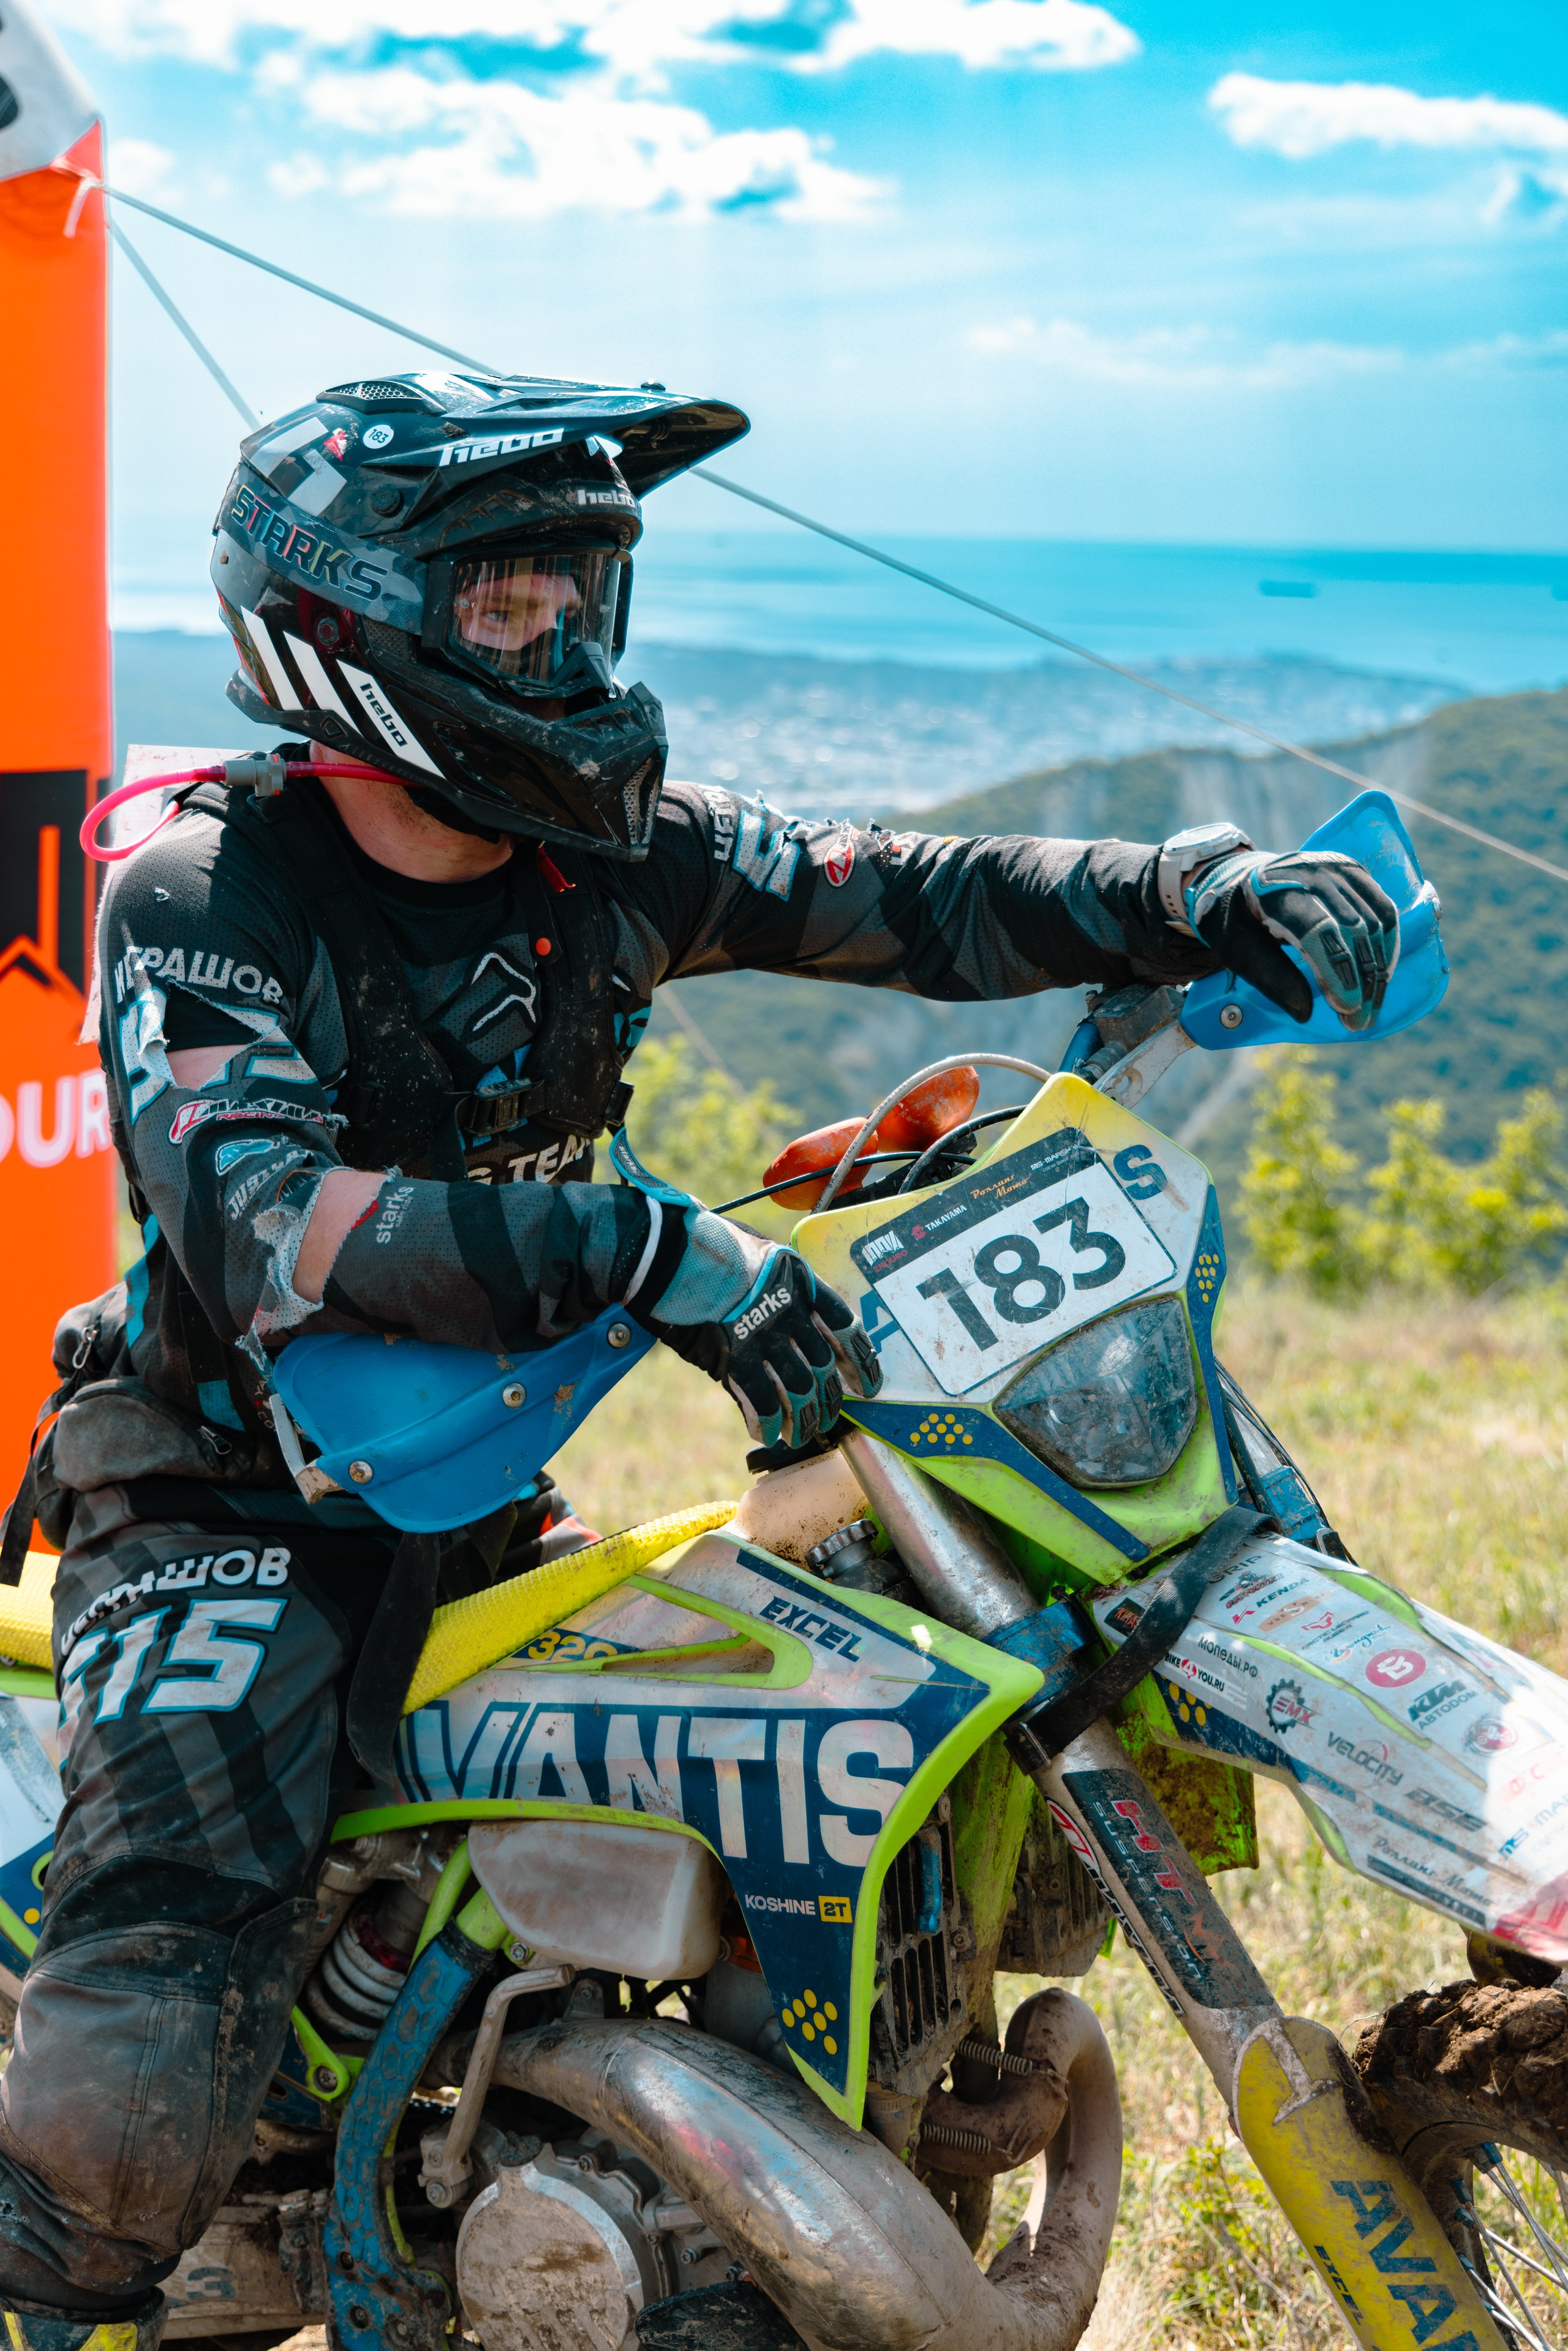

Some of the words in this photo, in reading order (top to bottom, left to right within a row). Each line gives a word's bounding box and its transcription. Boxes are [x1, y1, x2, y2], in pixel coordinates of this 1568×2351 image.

[368, 428, 388, 443] 183
[439, 428, 564, 467] hebo
[578, 489, 636, 508] hebo
[231, 484, 388, 602] STARKS
[360, 683, 407, 747] hebo
[619, 1145, 637, 1174] starks
[970, 1175, 1014, 1199] Роллинг
[995, 1176, 1030, 1199] Мото
[377, 1186, 413, 1243] starks
[925, 1205, 967, 1231] TAKAYAMA
[873, 1250, 908, 1273] ENDURO
[916, 1196, 1126, 1353] 183
[733, 1286, 792, 1340] starks
[1208, 1556, 1262, 1583] GRIP
[1256, 1577, 1310, 1607] KENDA
[760, 1596, 862, 1661] EXCEL
[1115, 1606, 1142, 1628] KIRA
[1272, 1694, 1316, 1726] EMX
[1407, 1678, 1468, 1723] KTM
[1328, 1732, 1404, 1787] VELOCITY
[395, 1702, 914, 1867] VANTIS
[744, 1893, 816, 1917] KOSHINE
[824, 1901, 848, 1918] 2T
[1314, 2244, 1364, 2326] EXCEL
